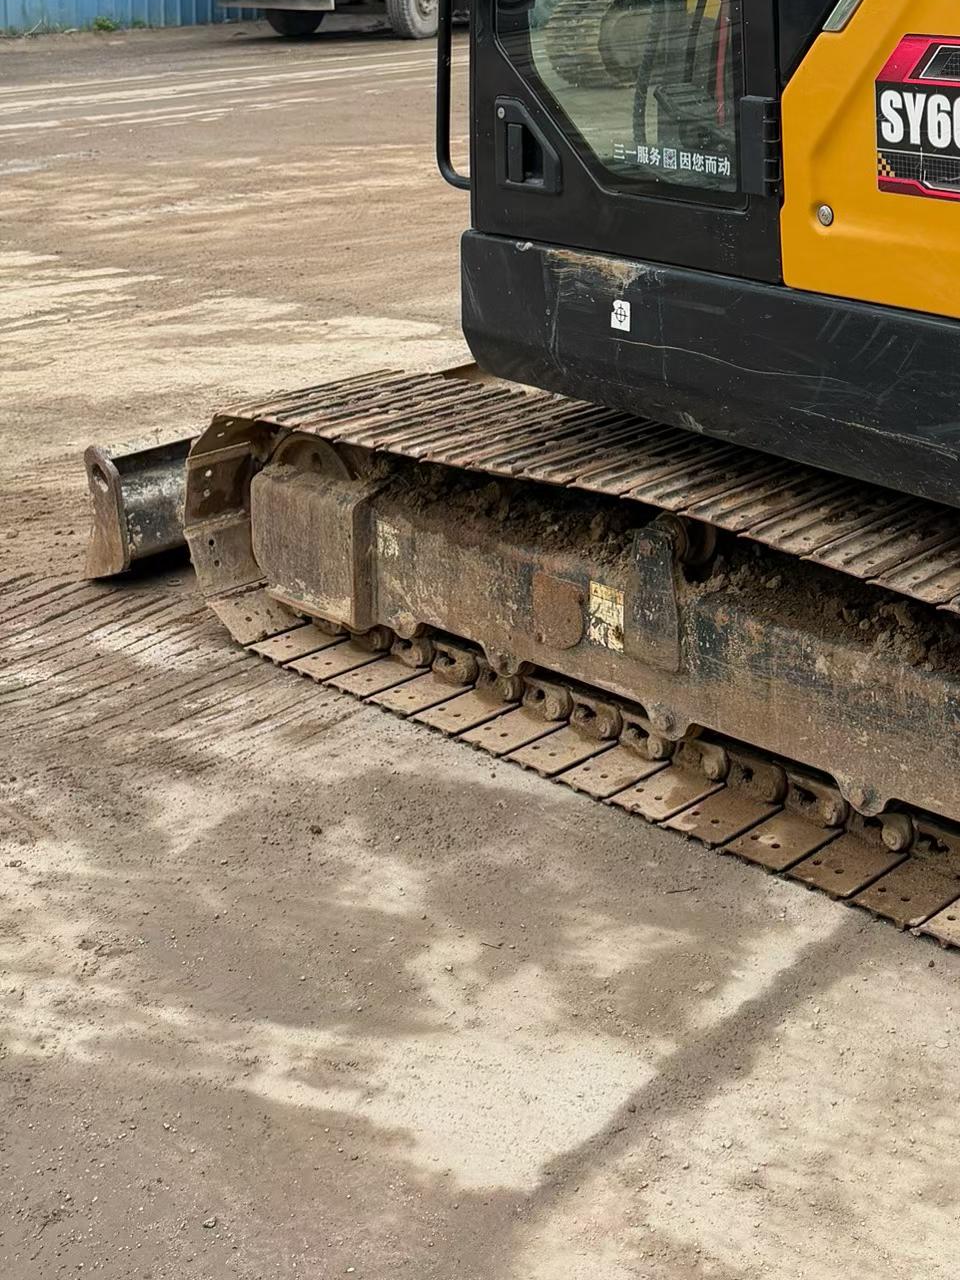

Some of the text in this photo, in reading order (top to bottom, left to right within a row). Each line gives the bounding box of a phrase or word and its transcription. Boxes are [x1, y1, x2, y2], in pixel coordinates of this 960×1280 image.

[613, 143, 731, 176] 三一服务 因您而动
